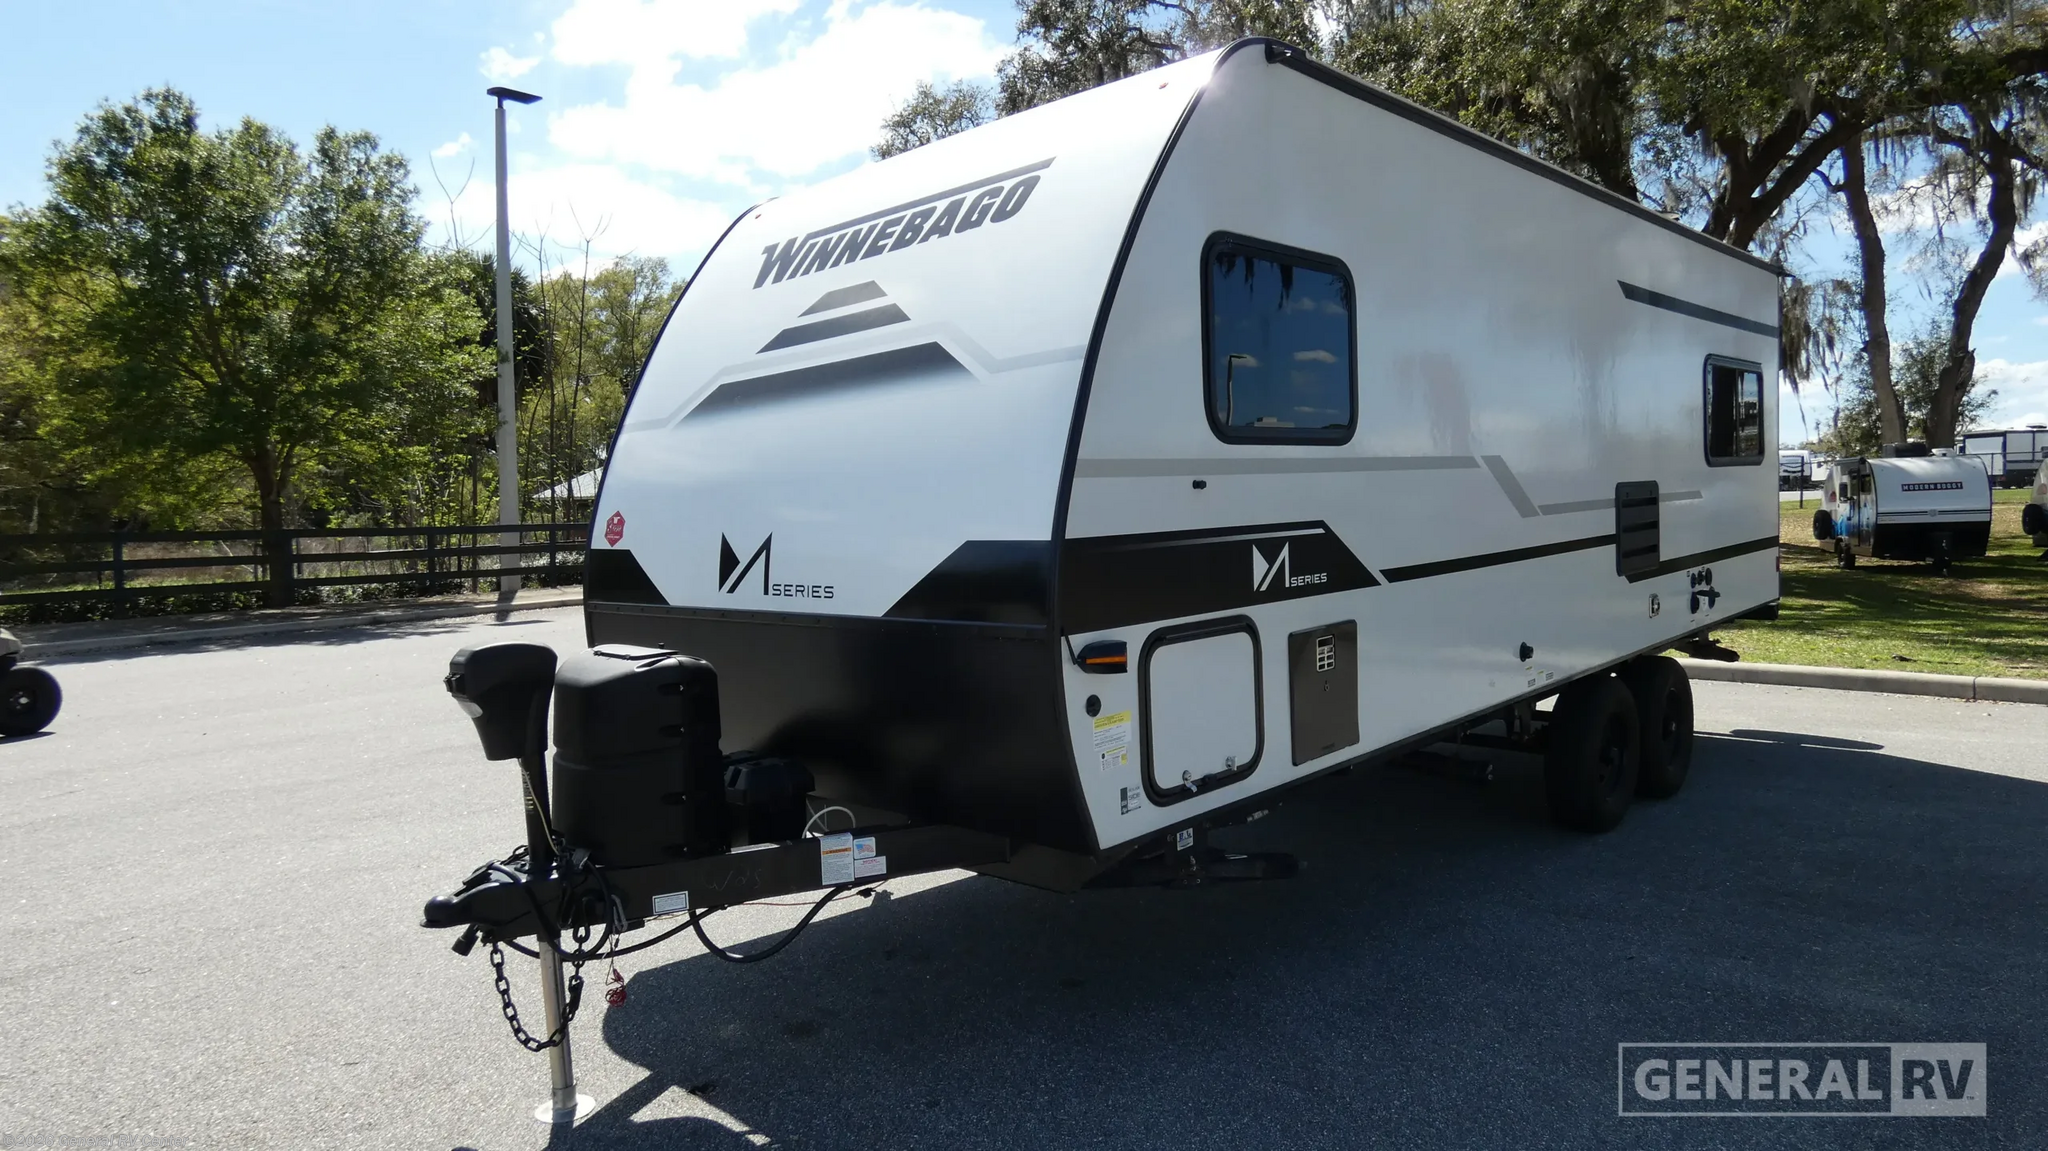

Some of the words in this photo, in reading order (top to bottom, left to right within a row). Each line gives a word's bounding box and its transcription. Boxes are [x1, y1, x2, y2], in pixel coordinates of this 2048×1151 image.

[752, 174, 1041, 290] WINNEBAGO
[1290, 572, 1328, 587] SERIES
[771, 583, 835, 599] SERIES
